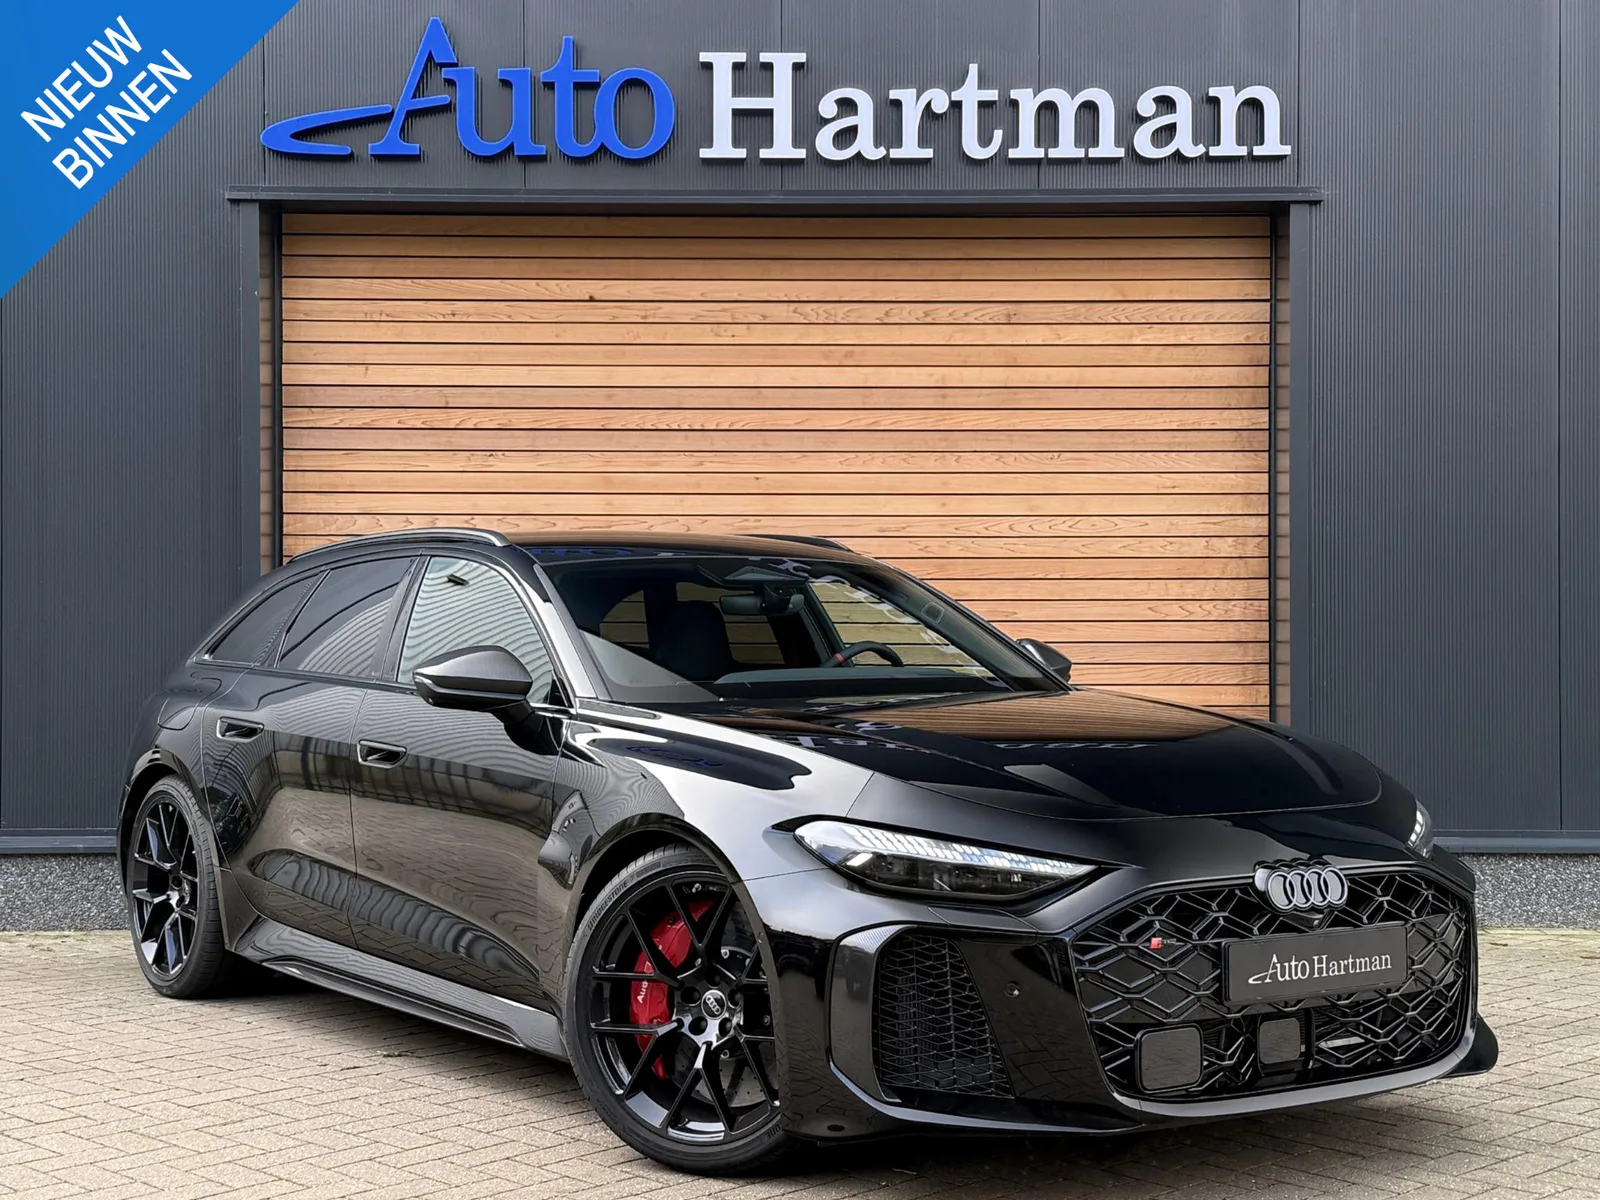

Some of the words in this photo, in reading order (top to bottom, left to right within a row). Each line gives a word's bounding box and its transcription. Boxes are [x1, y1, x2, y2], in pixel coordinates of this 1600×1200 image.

[260, 16, 675, 160] Auto
[699, 52, 1292, 160] Hartman
[1248, 953, 1310, 984] Auto
[1312, 953, 1393, 978] Hartman
